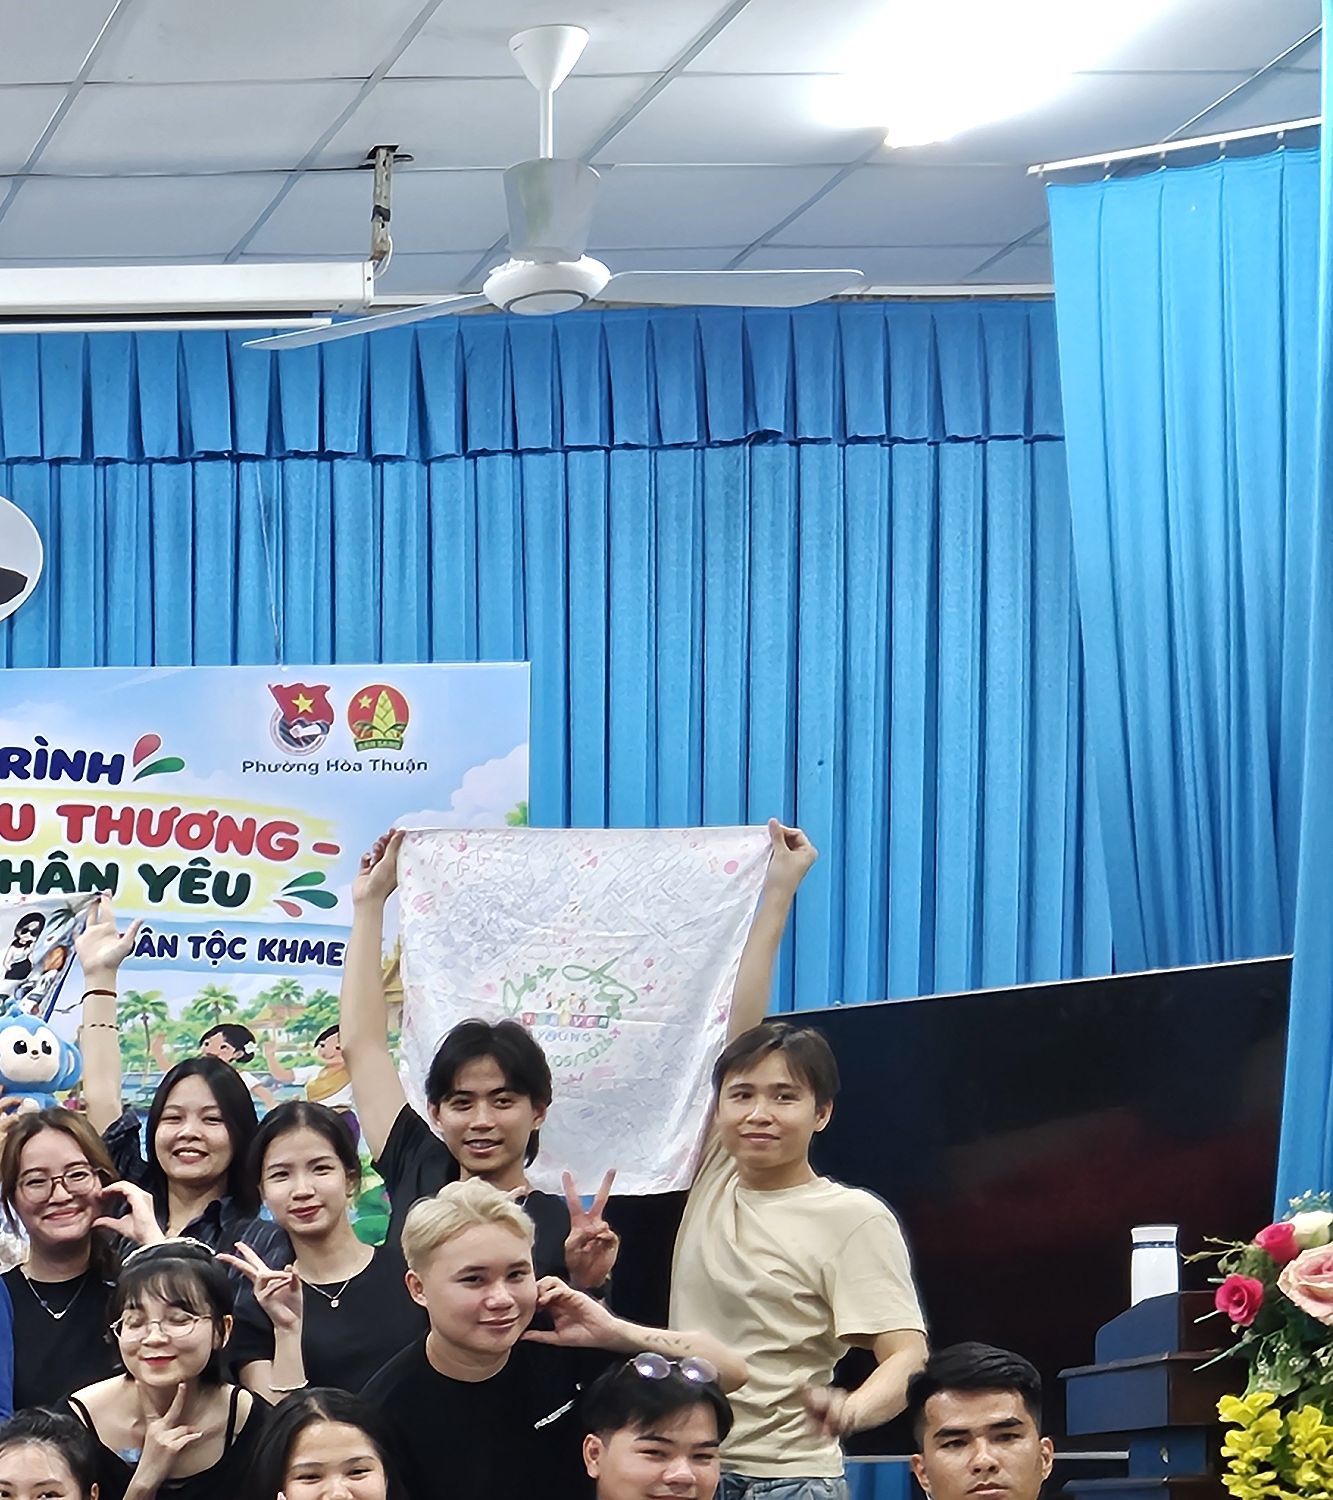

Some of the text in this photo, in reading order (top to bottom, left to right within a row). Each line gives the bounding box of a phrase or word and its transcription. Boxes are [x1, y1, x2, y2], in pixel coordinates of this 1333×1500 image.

[241, 758, 429, 776] Phường Hòa Thuận
[56, 801, 300, 863] THƯƠNG
[137, 856, 252, 908] YÊU
[187, 929, 248, 967] TỘC
[256, 937, 346, 967] KHME
